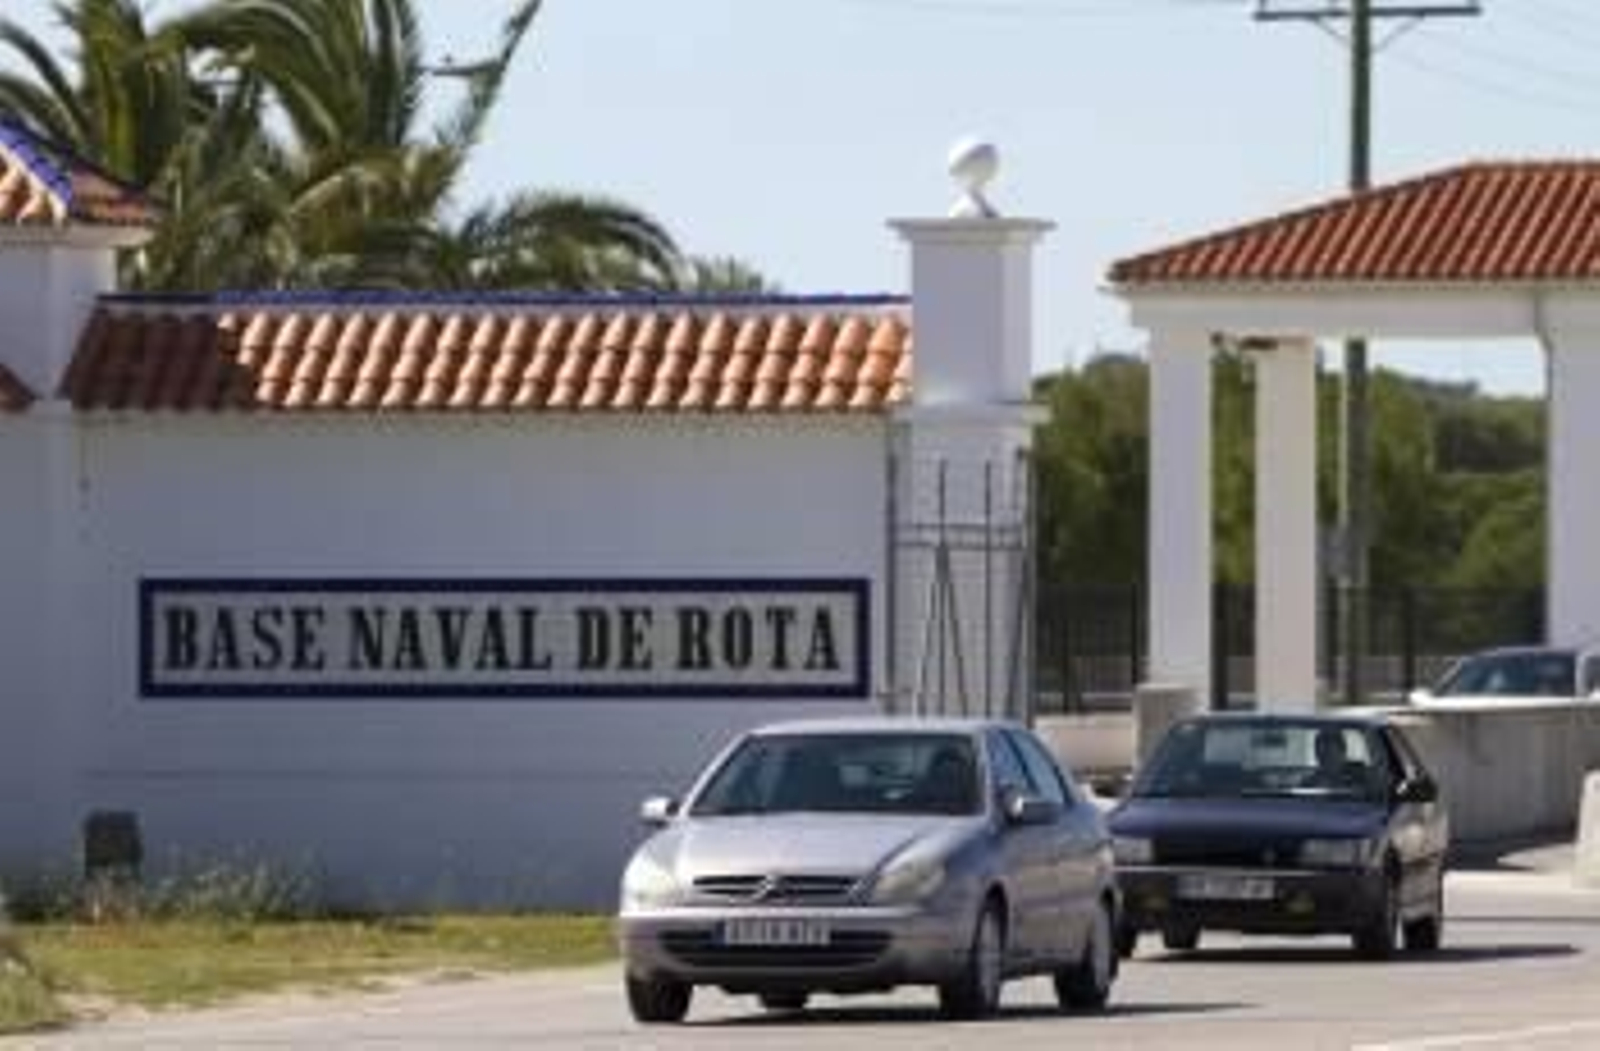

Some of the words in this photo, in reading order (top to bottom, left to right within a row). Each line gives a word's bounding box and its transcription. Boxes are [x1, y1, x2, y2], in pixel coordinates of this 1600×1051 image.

[163, 606, 326, 671] BASE
[346, 606, 552, 671] NAVAL
[575, 606, 651, 671] DE
[676, 606, 840, 671] ROTA
